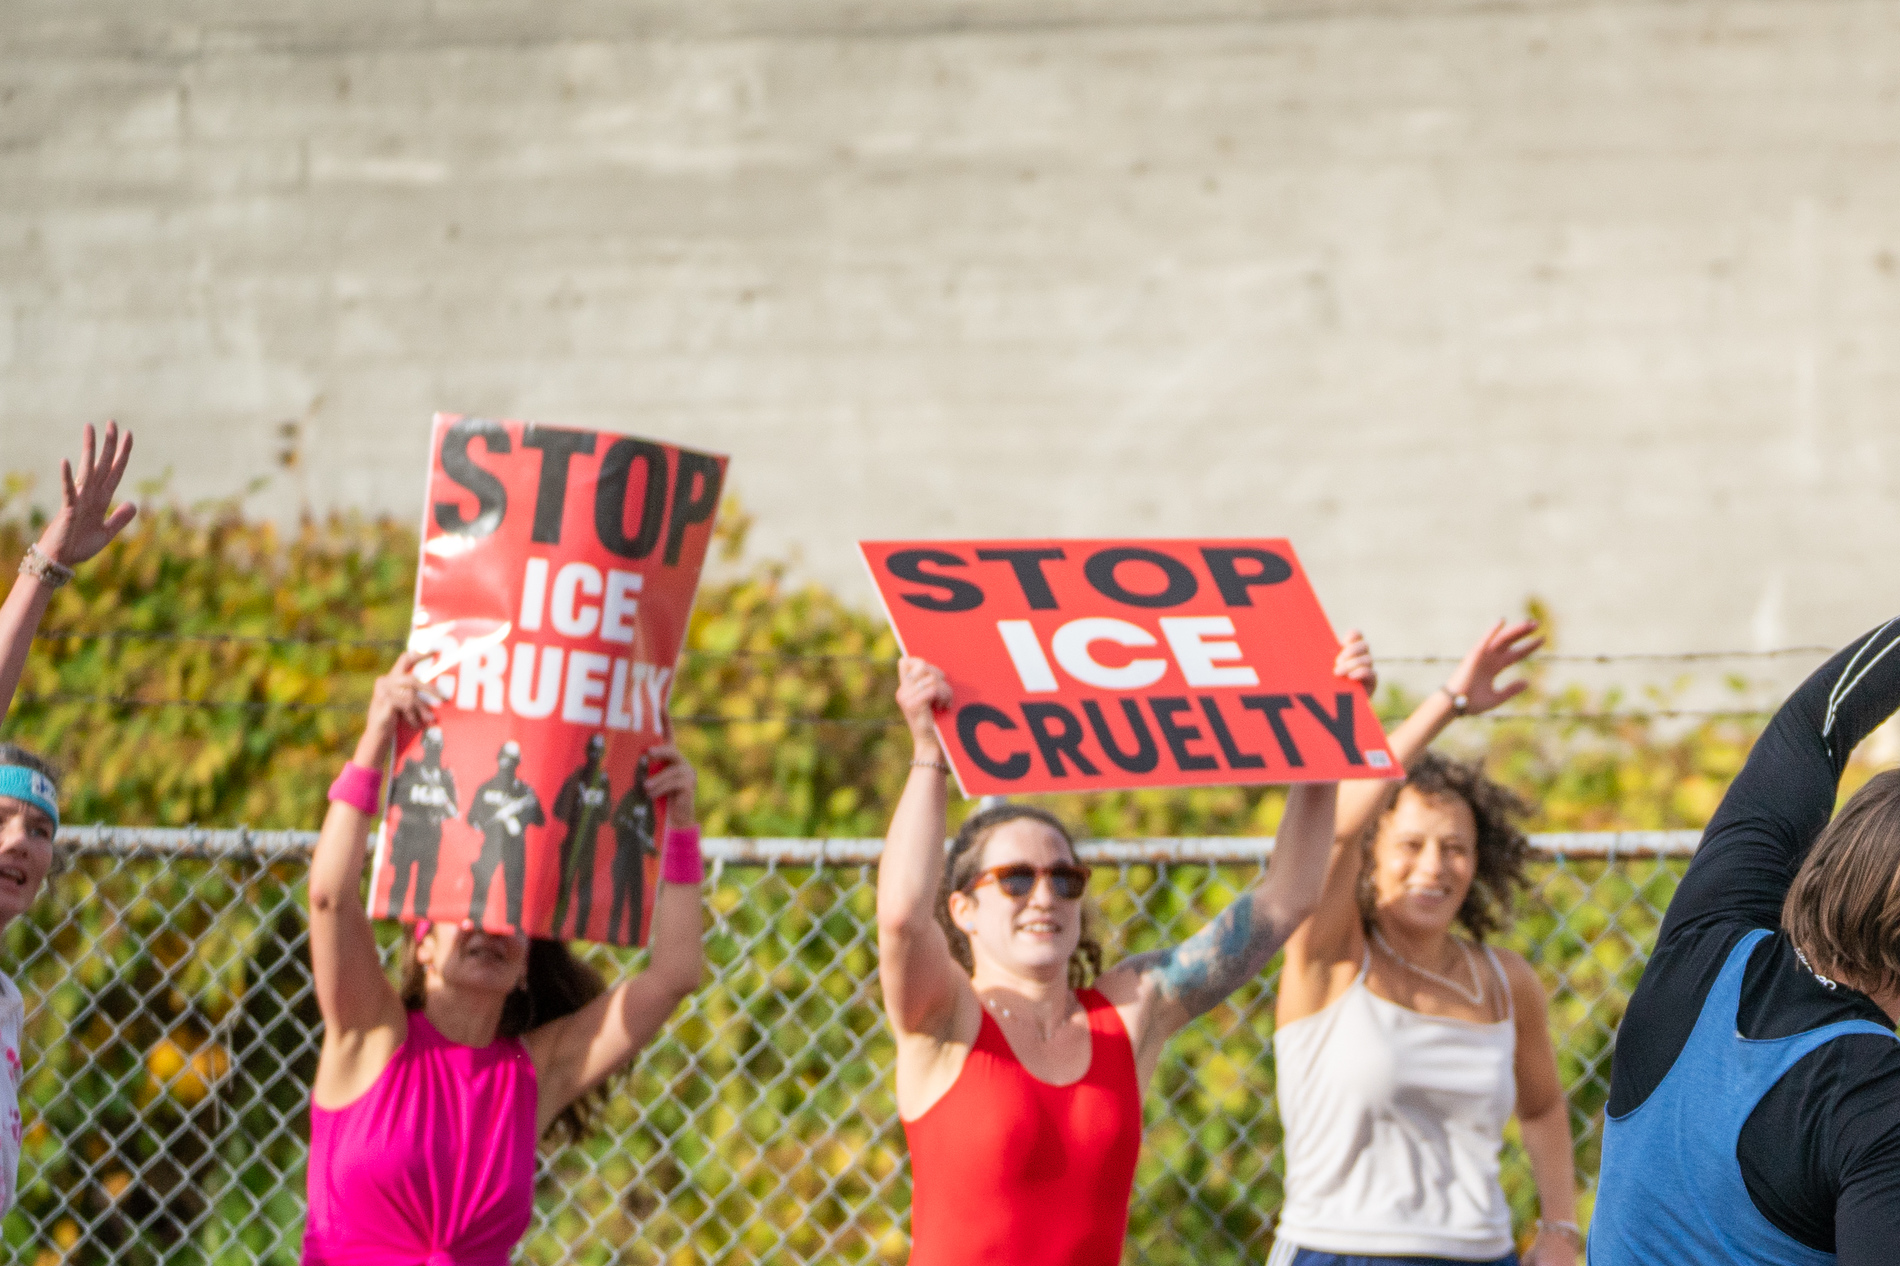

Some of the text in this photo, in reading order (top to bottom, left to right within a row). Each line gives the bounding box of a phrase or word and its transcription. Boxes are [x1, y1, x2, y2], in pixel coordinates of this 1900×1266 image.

[433, 419, 722, 568] STOP
[518, 556, 644, 643] ICE
[885, 546, 1293, 613] STOP
[996, 616, 1260, 693] ICE
[955, 692, 1366, 781] CRUELTY
